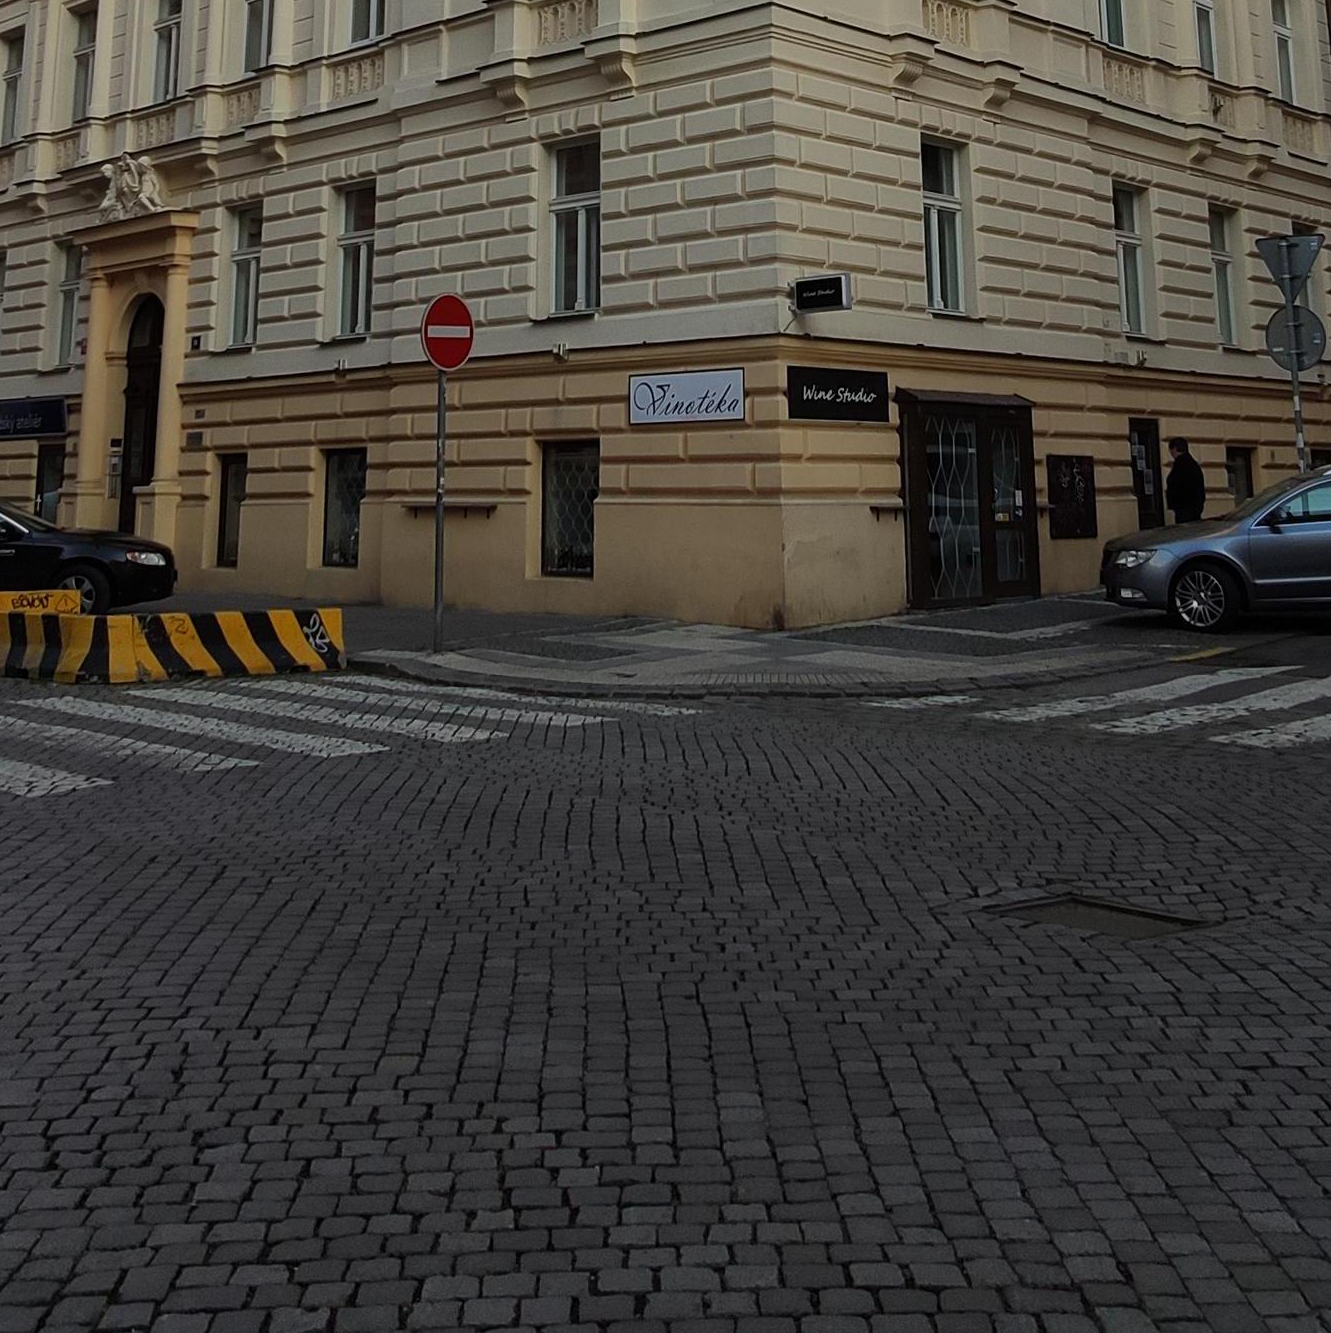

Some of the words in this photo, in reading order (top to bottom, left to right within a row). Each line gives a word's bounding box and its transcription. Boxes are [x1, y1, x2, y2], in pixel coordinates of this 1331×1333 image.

[633, 382, 740, 416] Vinotéka
[802, 384, 835, 402] Wine
[835, 386, 877, 404] Studio
